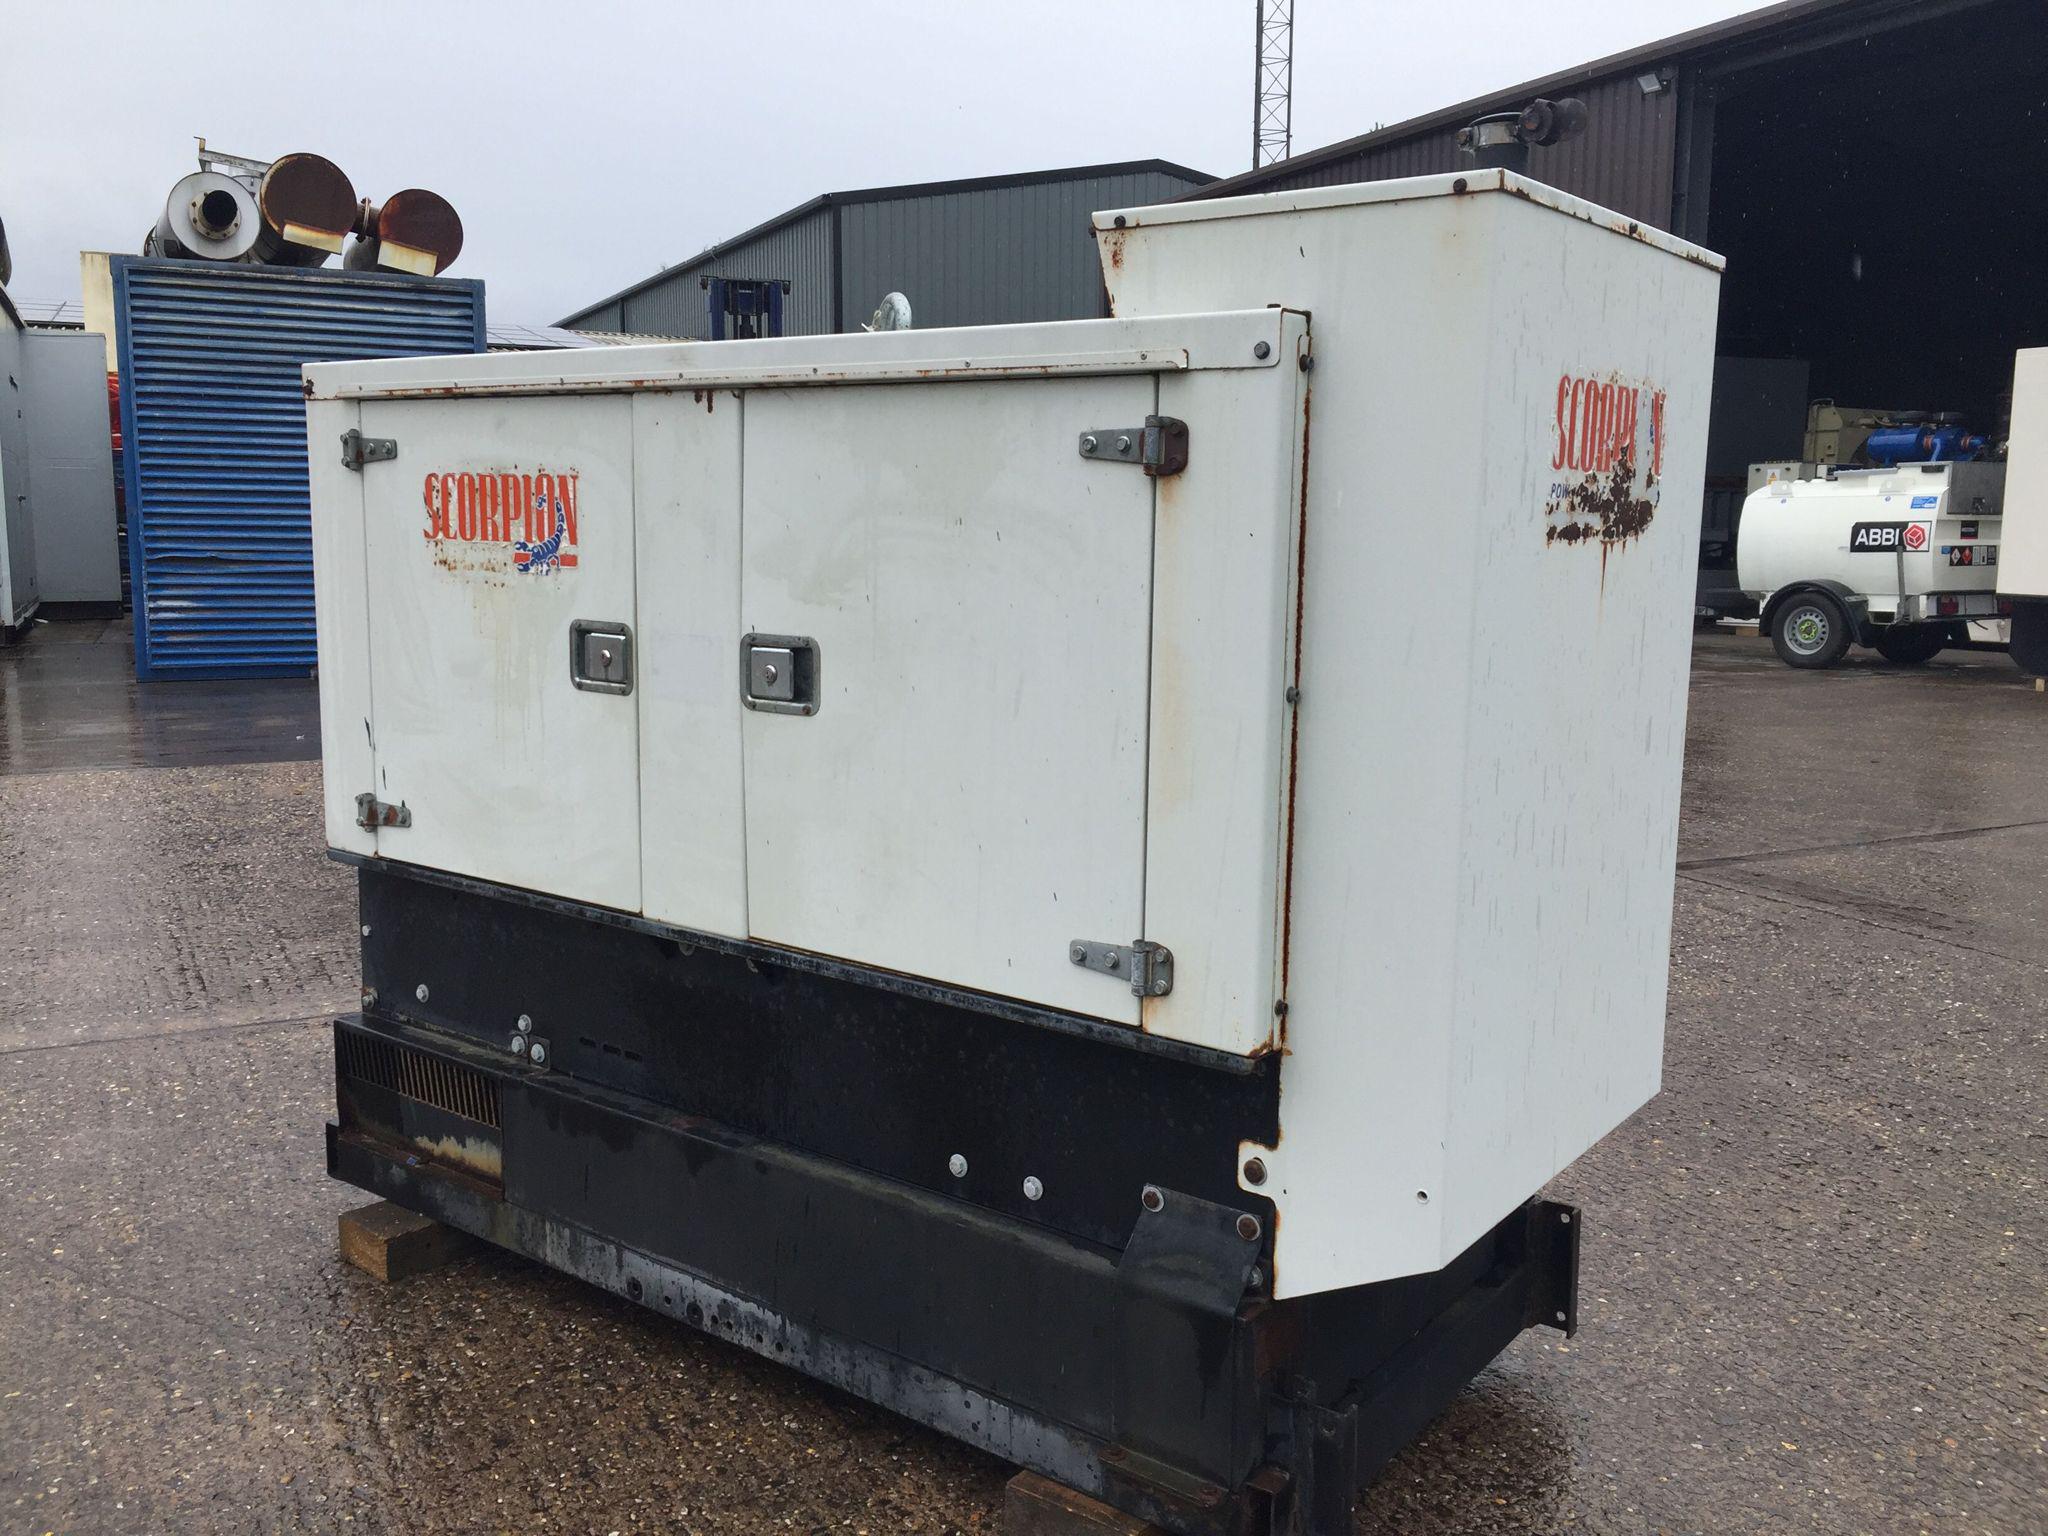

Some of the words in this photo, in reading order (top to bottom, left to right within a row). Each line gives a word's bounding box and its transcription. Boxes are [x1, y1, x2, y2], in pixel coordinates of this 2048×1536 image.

[1552, 375, 1666, 477] SCORPIN
[423, 472, 578, 545] SCORPION
[1855, 528, 1899, 546] ABBI
